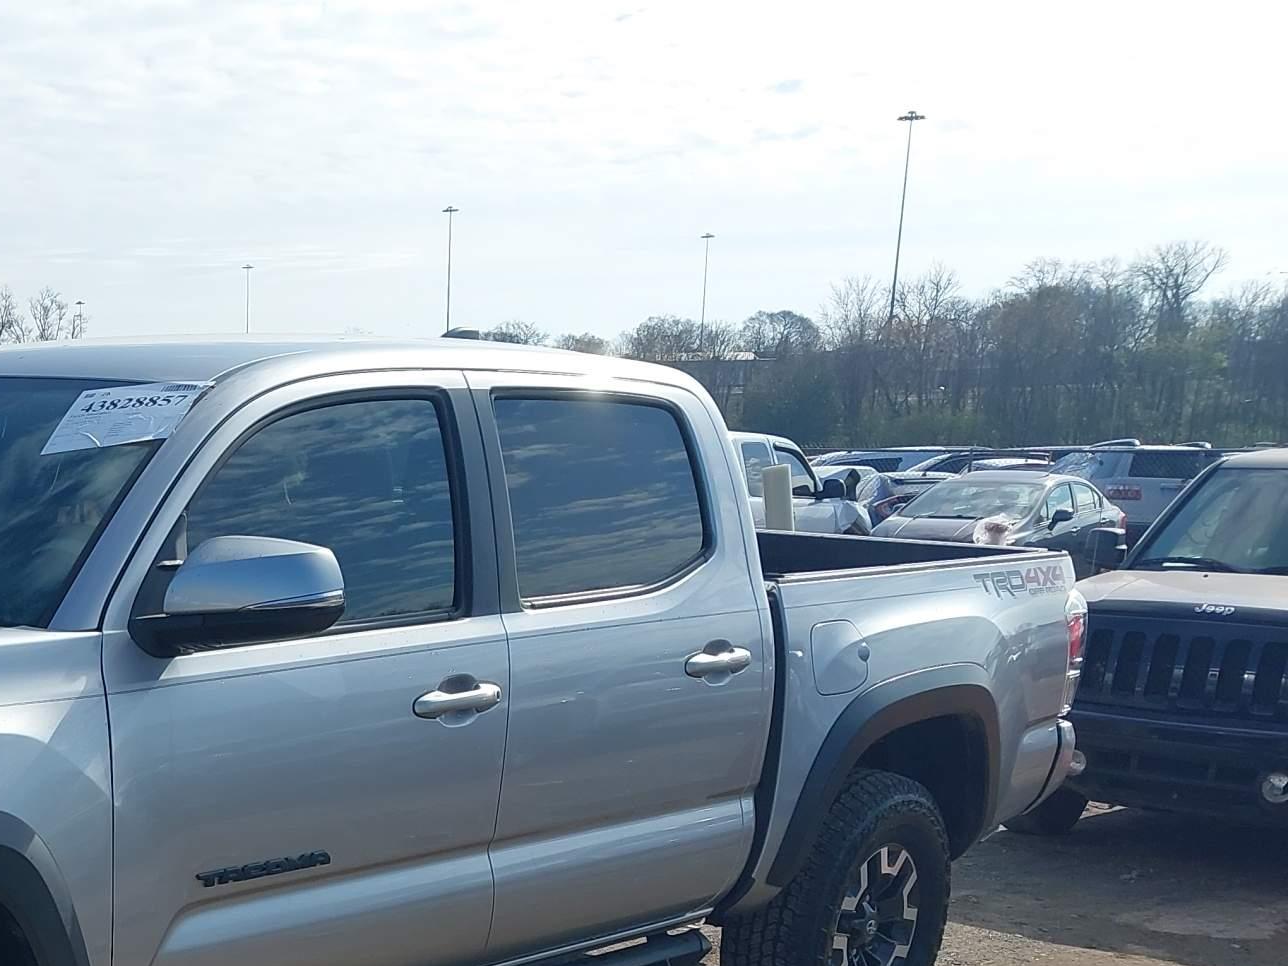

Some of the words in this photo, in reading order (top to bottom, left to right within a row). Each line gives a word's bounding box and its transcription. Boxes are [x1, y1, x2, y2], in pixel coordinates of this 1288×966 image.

[80, 394, 188, 413] 43828857
[1194, 603, 1236, 616] Jeep
[195, 850, 331, 887] TACOMA
